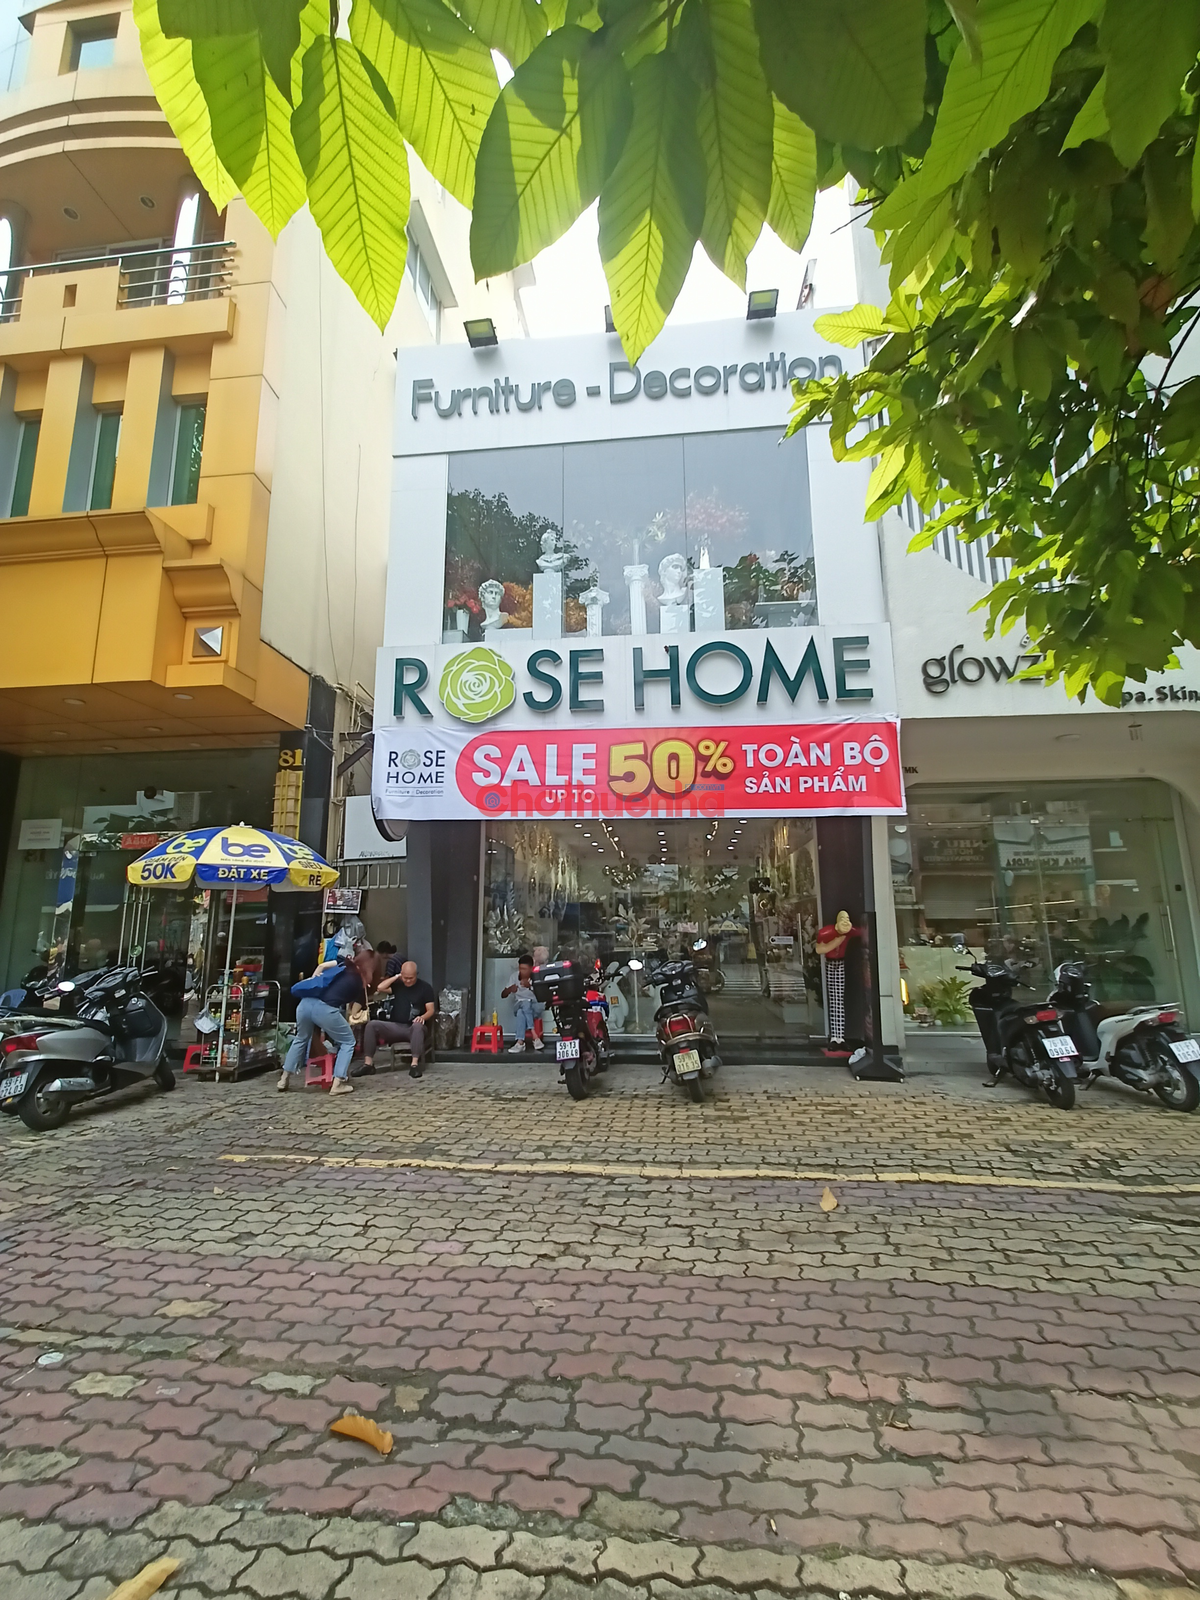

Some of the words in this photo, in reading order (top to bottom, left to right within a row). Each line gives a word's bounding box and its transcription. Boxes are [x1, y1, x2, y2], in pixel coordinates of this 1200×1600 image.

[411, 376, 576, 421] Furniture
[609, 352, 843, 405] Decoration
[633, 635, 875, 711] HOME
[921, 643, 1047, 694] glowz
[278, 748, 304, 767] 81
[741, 736, 832, 769] TOÀN
[843, 734, 890, 772] BỘ
[386, 771, 445, 784] HOME
[471, 743, 596, 787] SALE
[608, 738, 735, 799] 50%
[744, 771, 791, 794] SẢN
[799, 766, 867, 794] PHẨM
[385, 788, 411, 796] Furniture
[415, 788, 444, 796] Decoration
[545, 788, 568, 804] UP
[572, 788, 596, 804] TO
[166, 834, 207, 854] be
[221, 836, 271, 859] be
[140, 862, 177, 881] 50K
[218, 865, 246, 881] ĐẶT
[250, 869, 269, 881] XE
